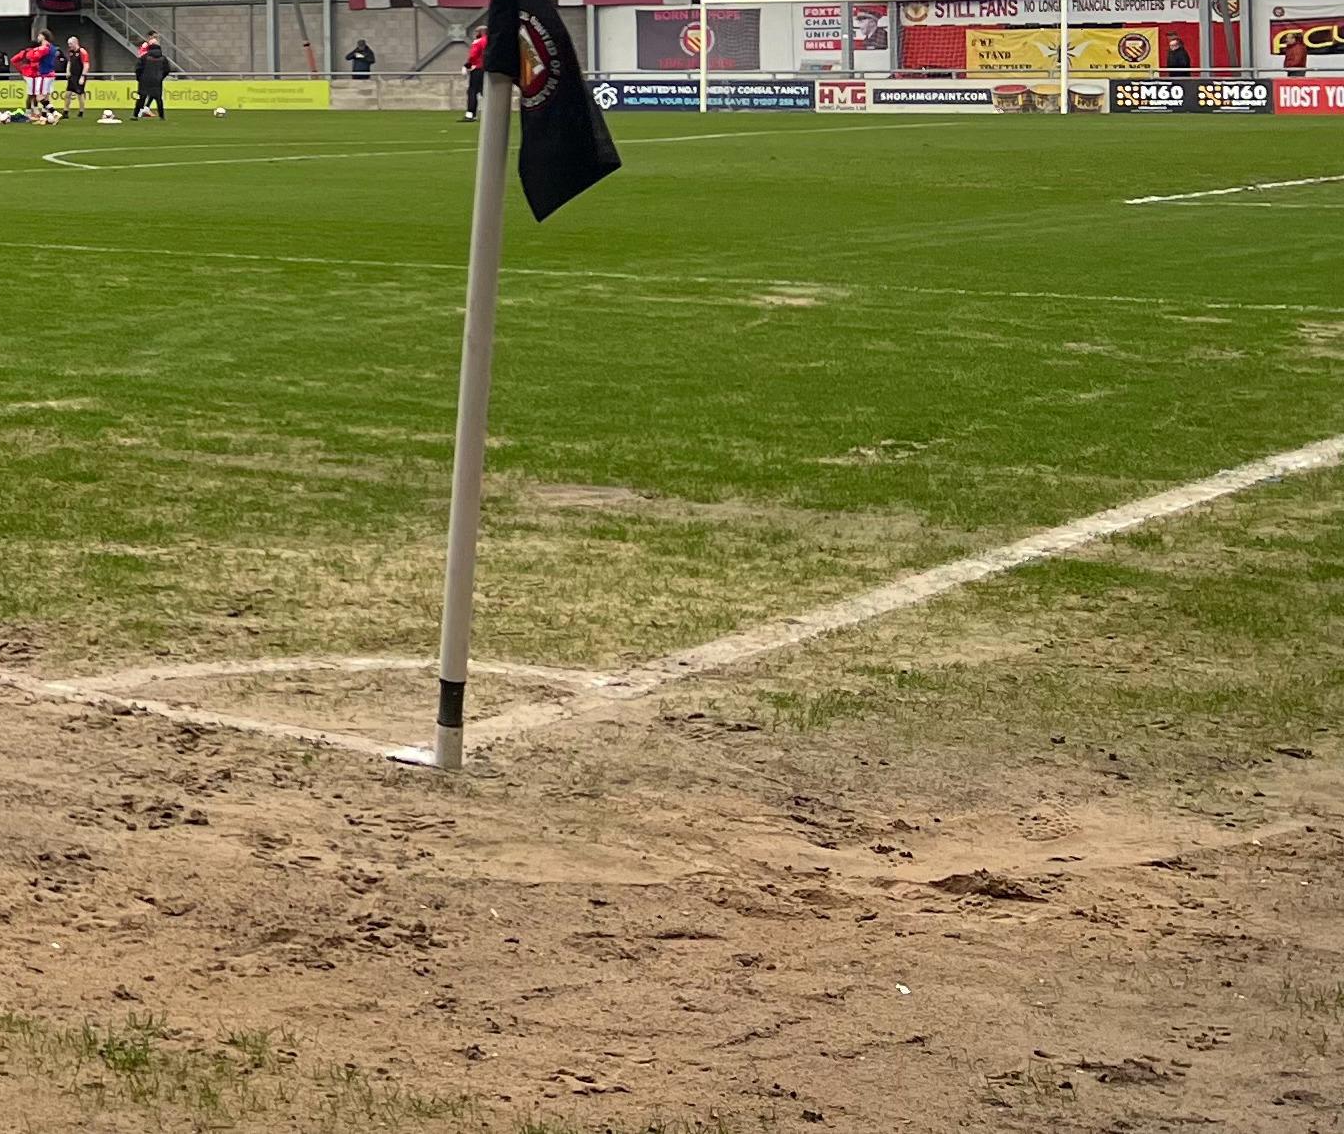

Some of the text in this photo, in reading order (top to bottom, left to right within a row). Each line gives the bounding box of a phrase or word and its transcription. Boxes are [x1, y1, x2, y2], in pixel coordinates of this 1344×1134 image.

[935, 1, 974, 18] STILL
[980, 0, 1018, 17] FANS
[1024, 1, 1035, 12] NO
[1072, 0, 1111, 12] FINANCIAL
[654, 11, 688, 21] BORN
[806, 41, 834, 49] MIKE
[979, 51, 1011, 59] STAND
[624, 85, 809, 95] FC UNITED'S NO.1 NERGY CONSULTANCY!
[819, 82, 866, 105] HMG
[1140, 85, 1184, 100] M60
[1223, 85, 1267, 100] M60
[624, 97, 658, 105] HELPING
[660, 97, 685, 105] YOUR
[880, 92, 988, 102] SHOP.HMGPAINT.COM
[1279, 85, 1320, 108] HOST
